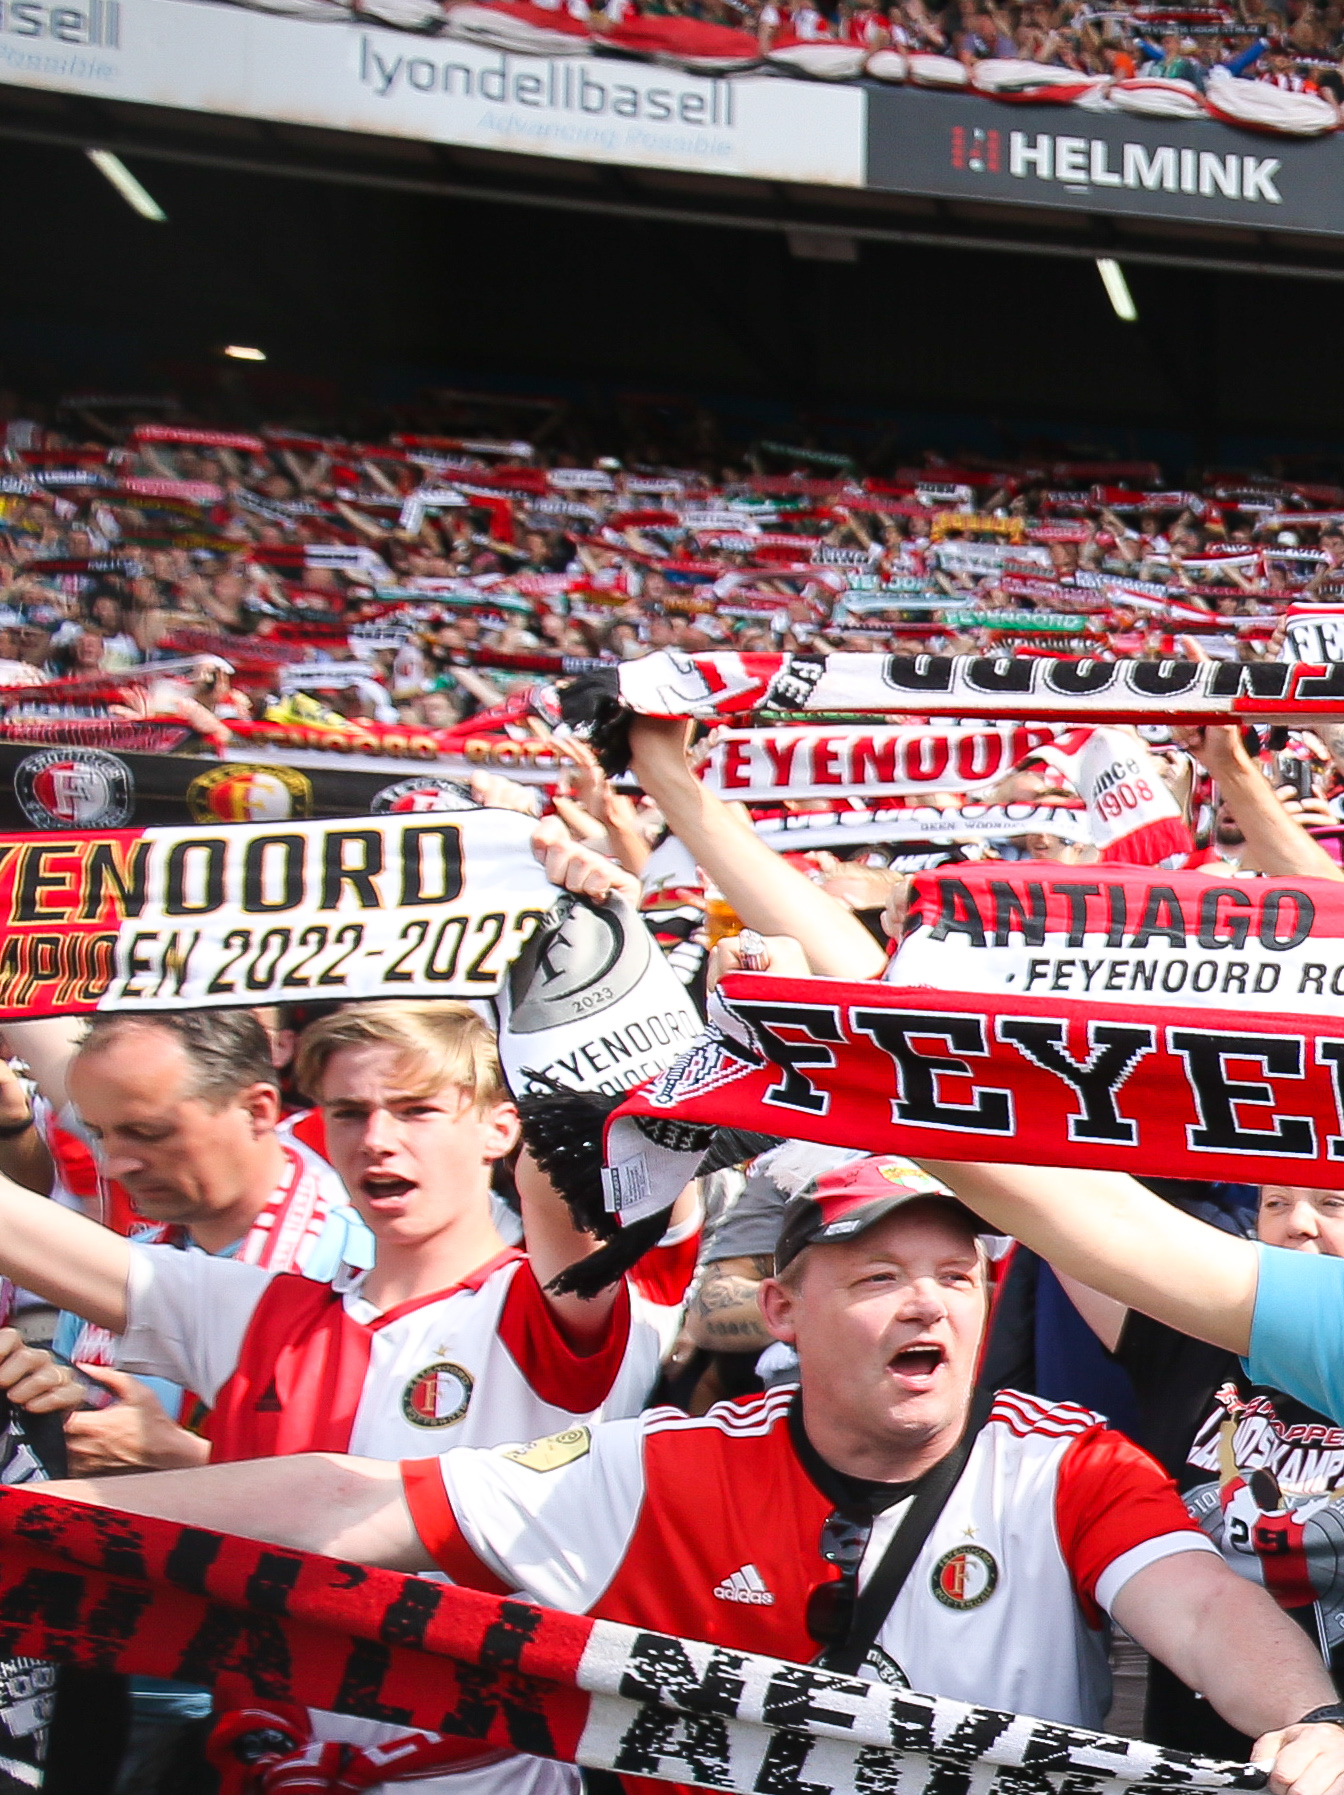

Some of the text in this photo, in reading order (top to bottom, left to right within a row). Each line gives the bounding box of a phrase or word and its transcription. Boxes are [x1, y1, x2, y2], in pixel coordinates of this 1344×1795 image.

[359, 35, 736, 128] lyondellbasell
[1007, 129, 1283, 204] HELMINK
[694, 727, 1056, 789] EYENOOR
[1096, 779, 1154, 823] 1908
[927, 878, 1314, 953] ANTIAGO
[571, 987, 615, 1014] 2023
[1024, 957, 1281, 994] FEYENOORD
[524, 1009, 698, 1094] YENOORD
[713, 1584, 775, 1606] adidas
